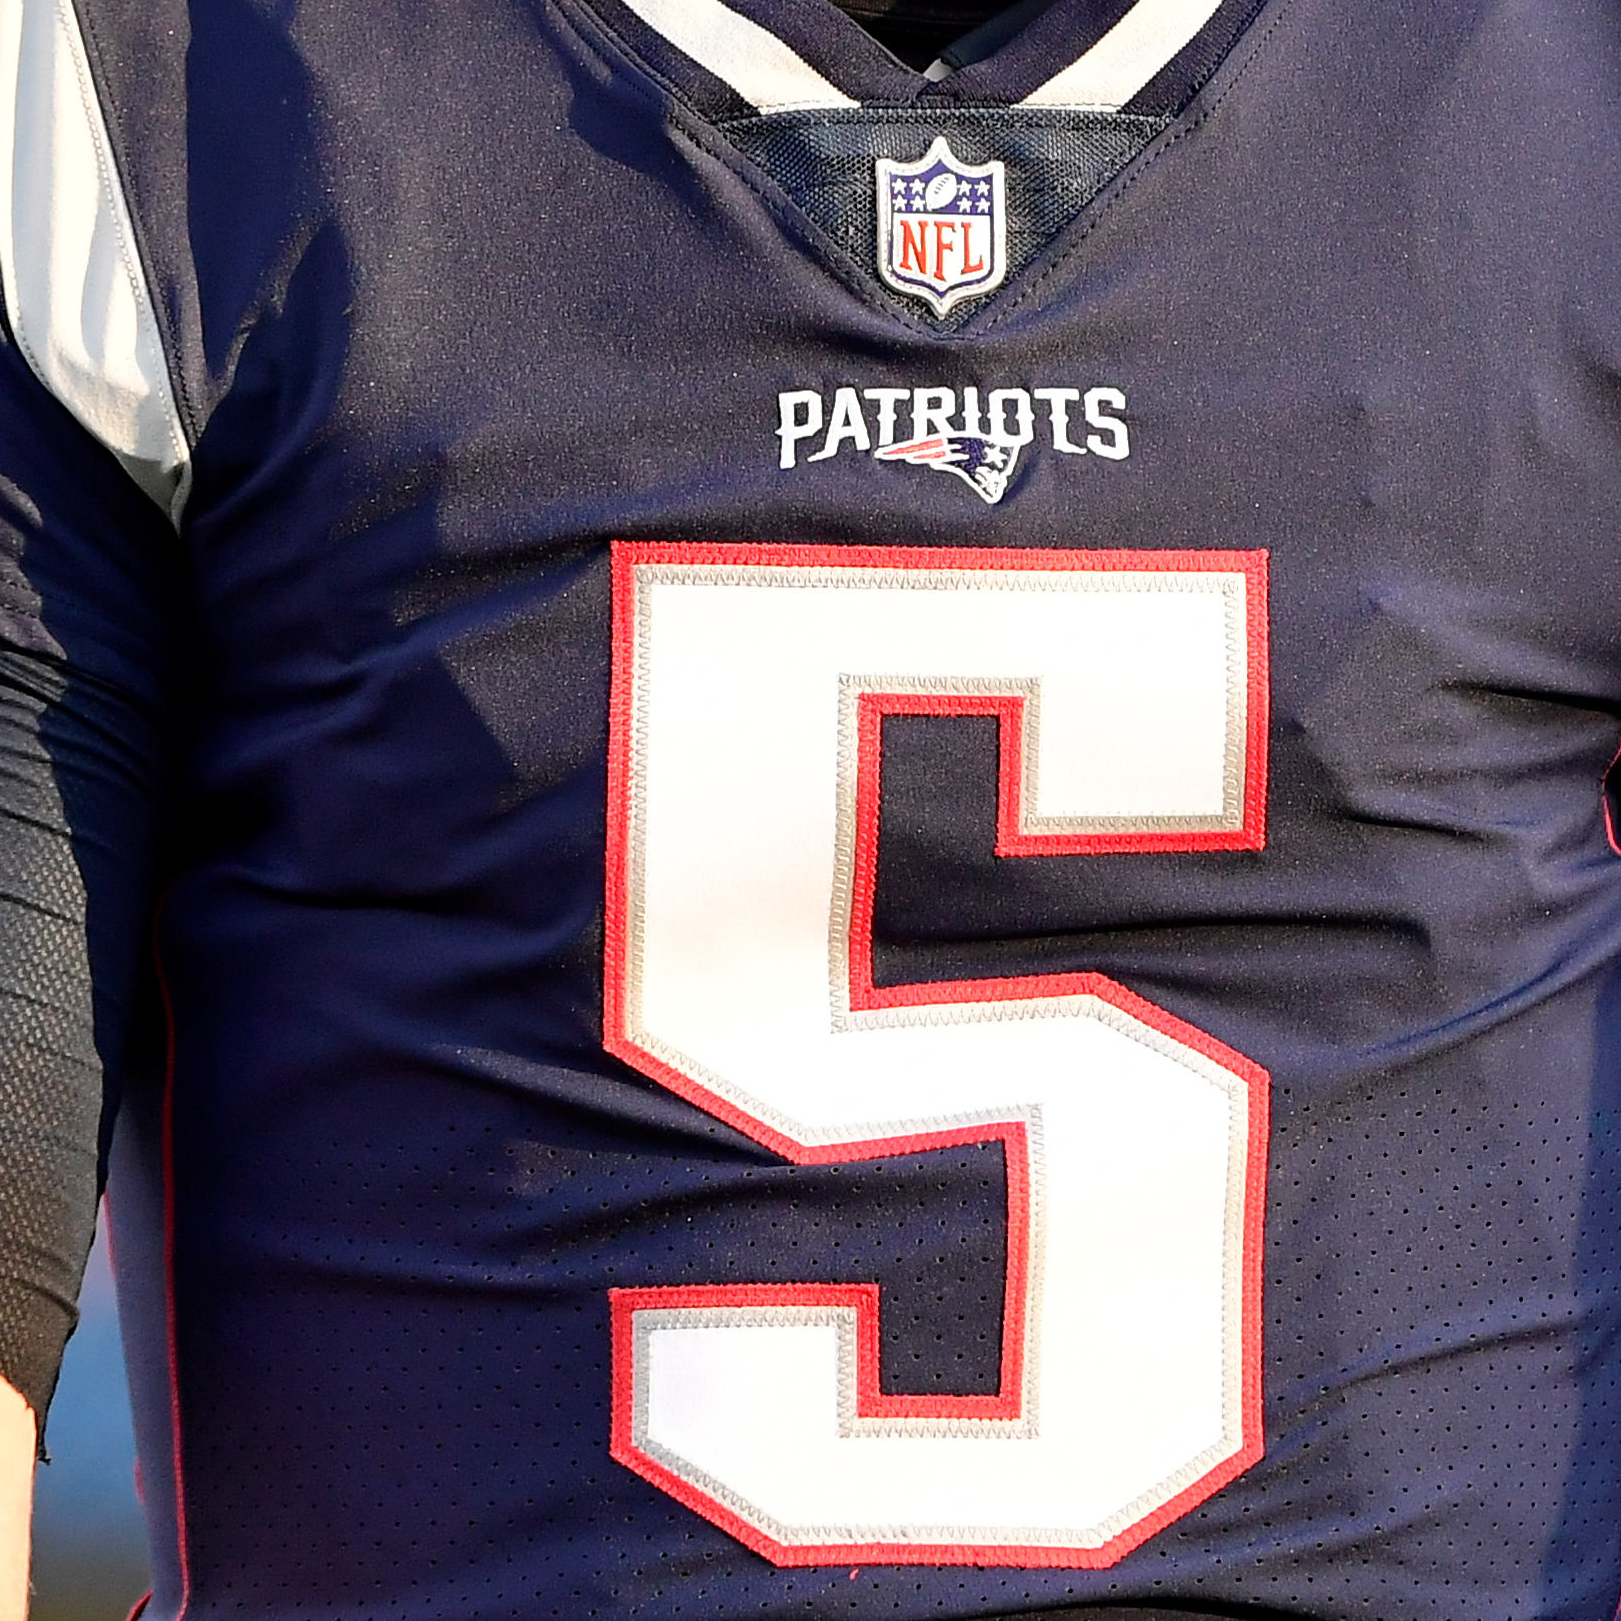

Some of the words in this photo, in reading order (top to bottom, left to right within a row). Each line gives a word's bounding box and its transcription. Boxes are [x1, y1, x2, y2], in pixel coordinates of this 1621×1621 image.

[899, 219, 984, 282] NFL
[776, 386, 1130, 470] PATRIOTS
[602, 540, 1271, 1569] 5
